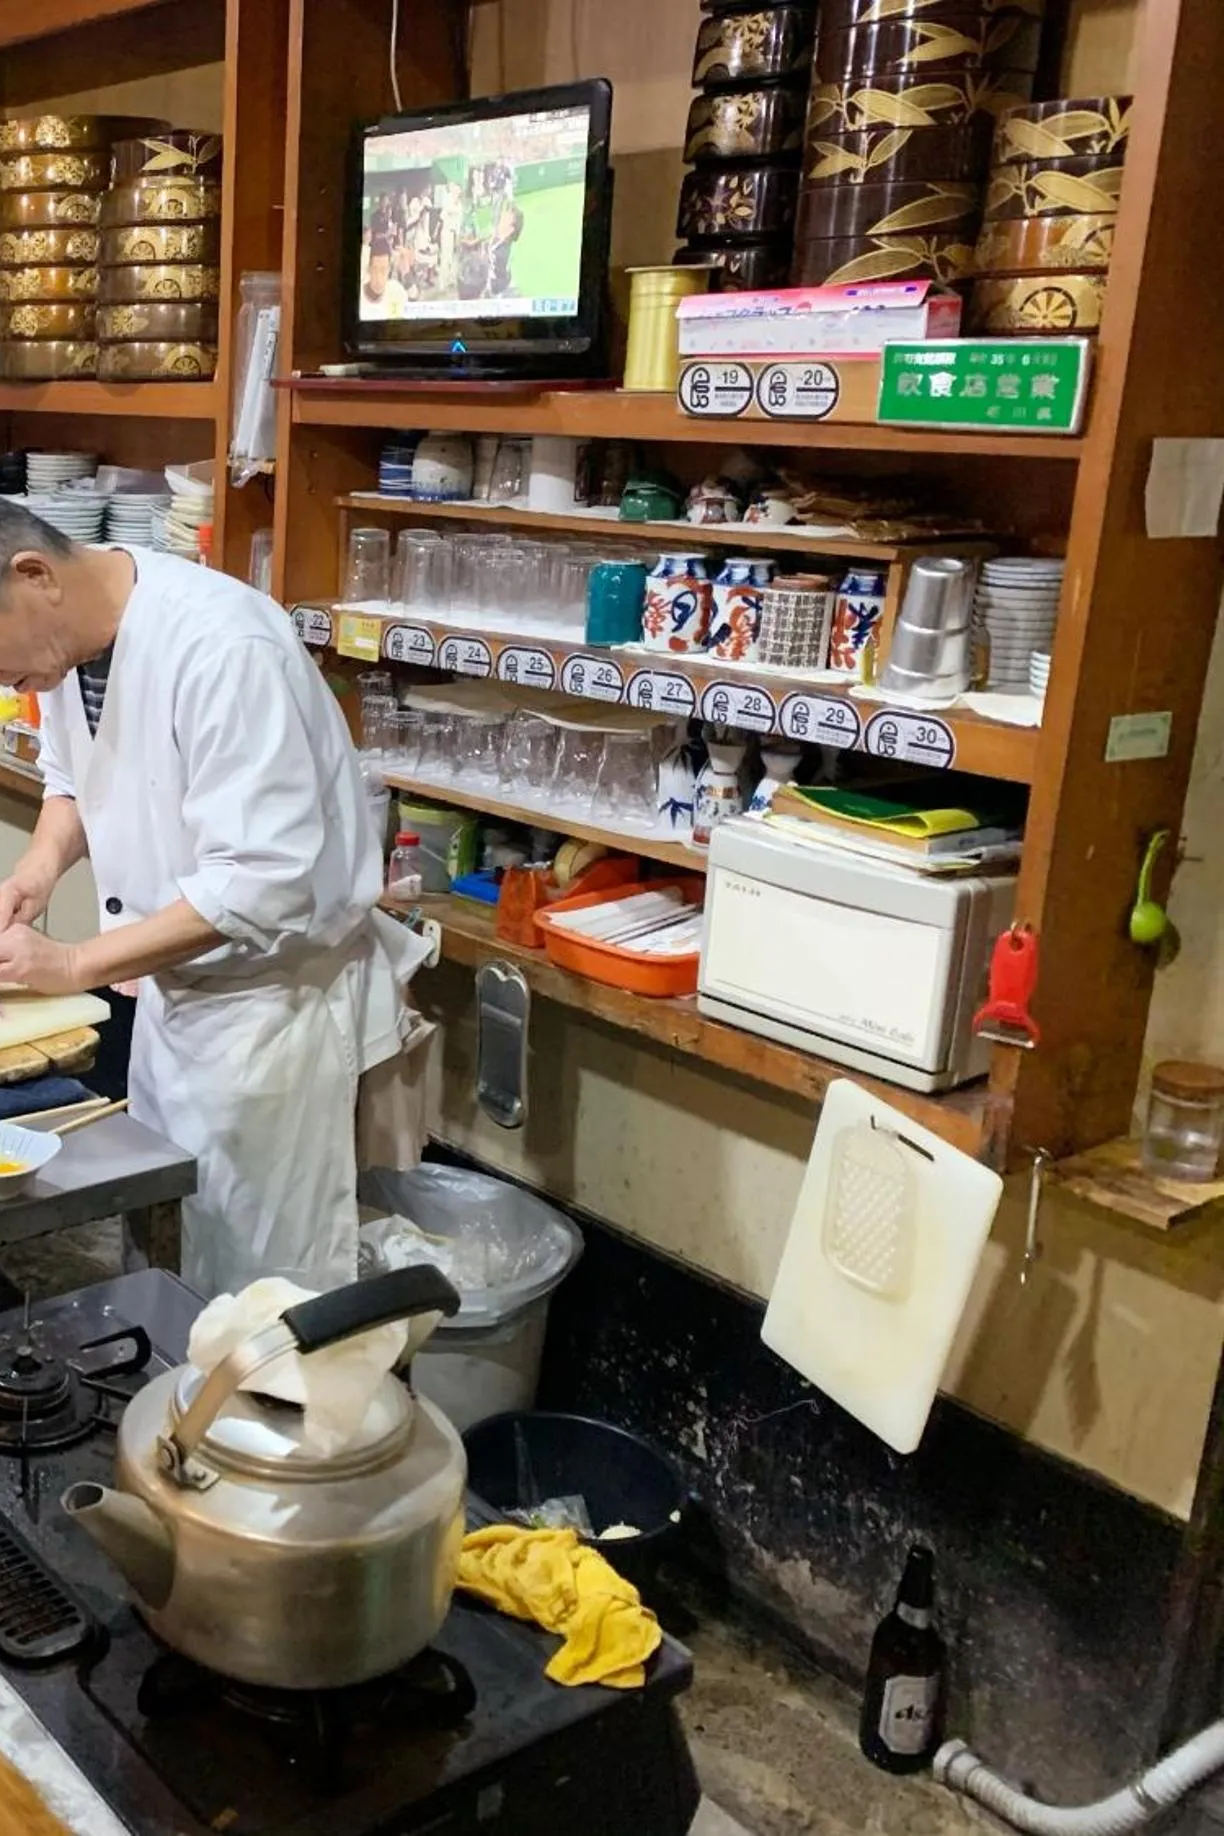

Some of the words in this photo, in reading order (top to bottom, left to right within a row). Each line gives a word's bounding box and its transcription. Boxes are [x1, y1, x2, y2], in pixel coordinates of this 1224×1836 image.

[722, 369, 739, 384] 19
[803, 369, 824, 386] 20
[312, 614, 325, 626] 22
[413, 634, 426, 647] 23
[467, 646, 481, 659] 24
[529, 656, 544, 671] 25
[596, 667, 613, 683] 26
[666, 682, 683, 697] 27
[743, 694, 761, 711] 28
[825, 707, 845, 724] 29
[915, 726, 938, 744] 30
